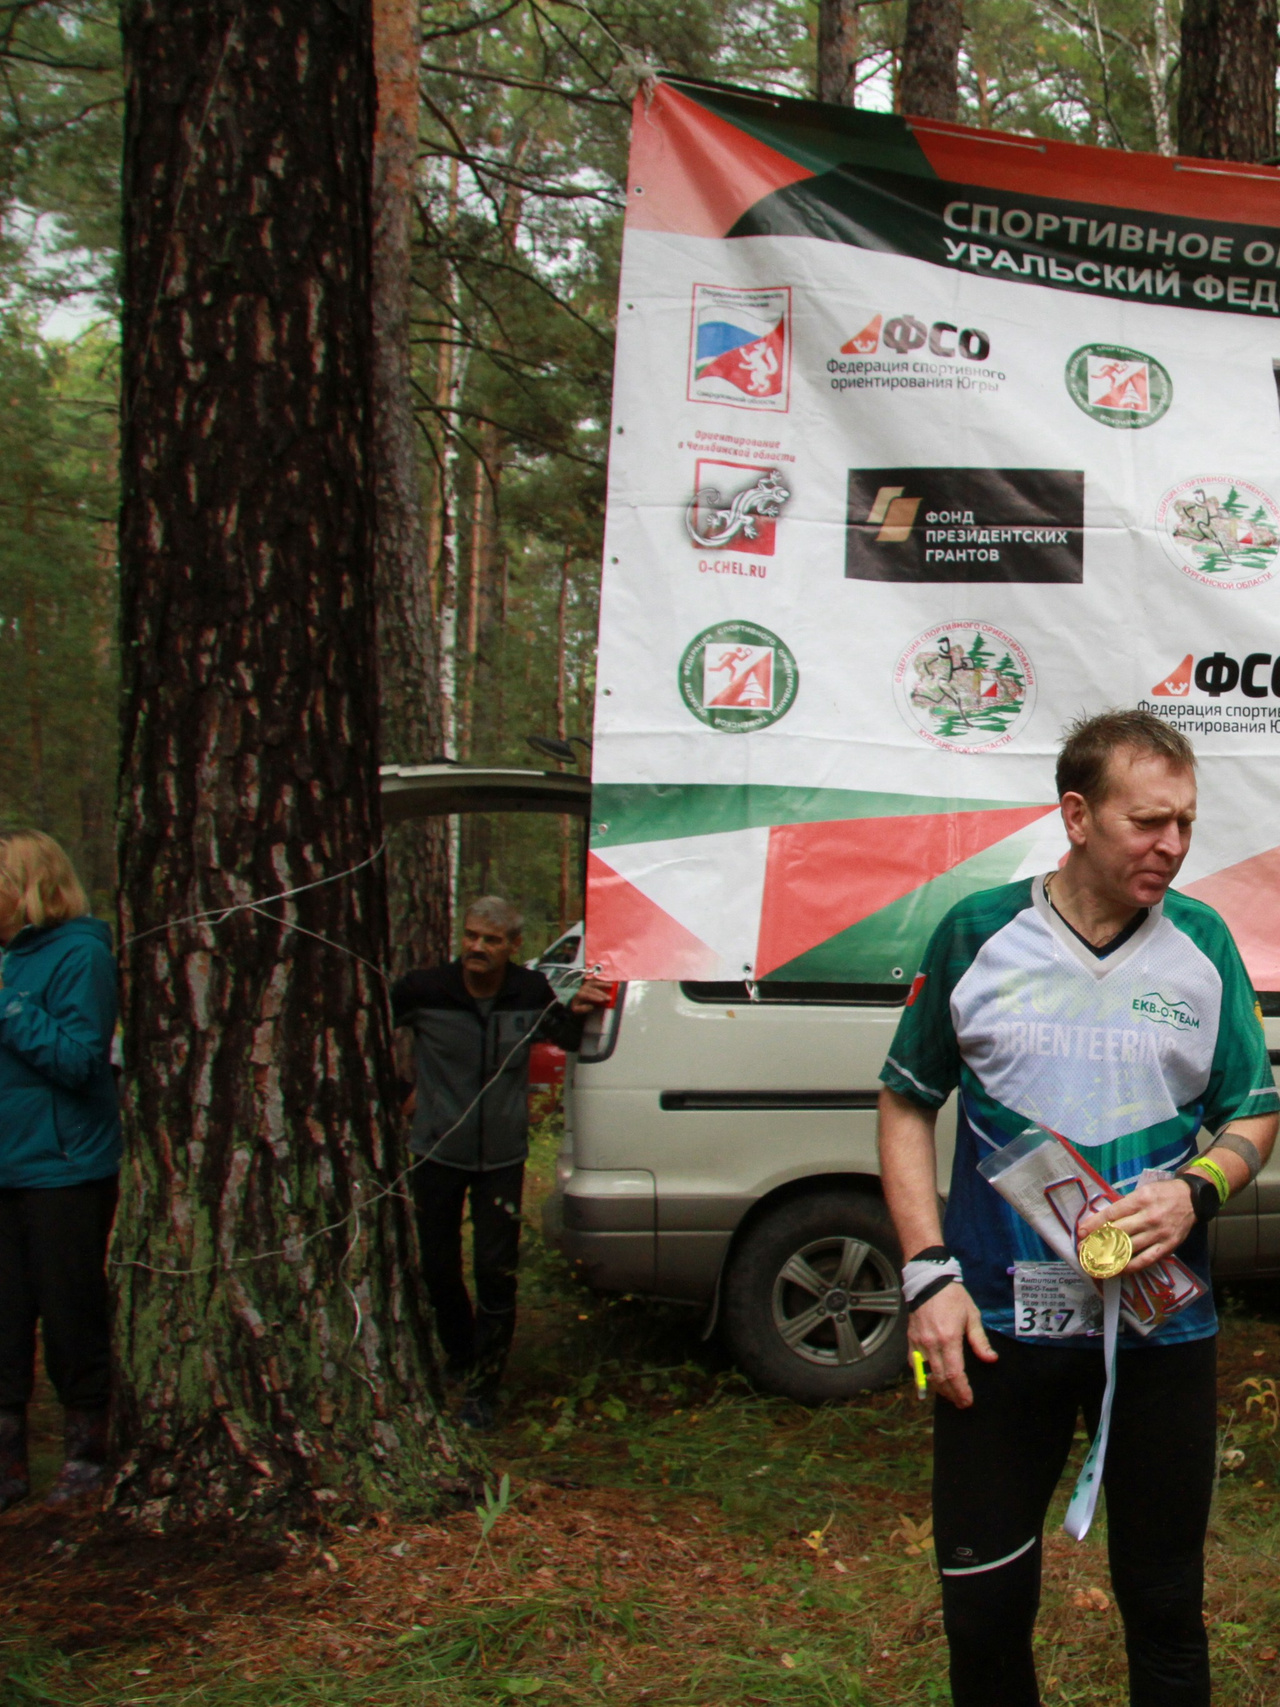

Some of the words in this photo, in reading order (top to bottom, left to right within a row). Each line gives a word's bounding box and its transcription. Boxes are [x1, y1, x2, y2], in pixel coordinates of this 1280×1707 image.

[943, 201, 1234, 263] СПОРТИВНОЕ
[943, 237, 1181, 298] УРАЛЬСКИЙ
[882, 314, 990, 361] ФСО
[827, 358, 909, 375] Федерация
[913, 361, 1006, 380] спортивного
[831, 376, 952, 392] ориентирования
[956, 376, 999, 393] Югры
[695, 430, 780, 448] Ориентирование
[687, 441, 750, 457] Челябинской
[753, 451, 795, 462] области
[925, 511, 974, 524] ФОНД
[925, 530, 1068, 544] ПРЕЗИДЕНТСКИХ
[925, 549, 1000, 562] ГРАНТОВ
[698, 560, 766, 578] O-CHEL.RU
[1182, 565, 1234, 589] КУРГАНСКОЙ
[1236, 572, 1273, 590] ОБЛАСТИ
[717, 625, 776, 645] СПОРТИВНОГО
[920, 622, 980, 642] СПОРТИВНОГО
[981, 624, 1034, 686] ОРИЕНТИРОВАНИЯ
[1137, 699, 1222, 718] Федерация
[1166, 720, 1266, 735] ентирования
[1132, 998, 1200, 1029] EKB-O-TEAM
[1019, 1307, 1075, 1333] 317
